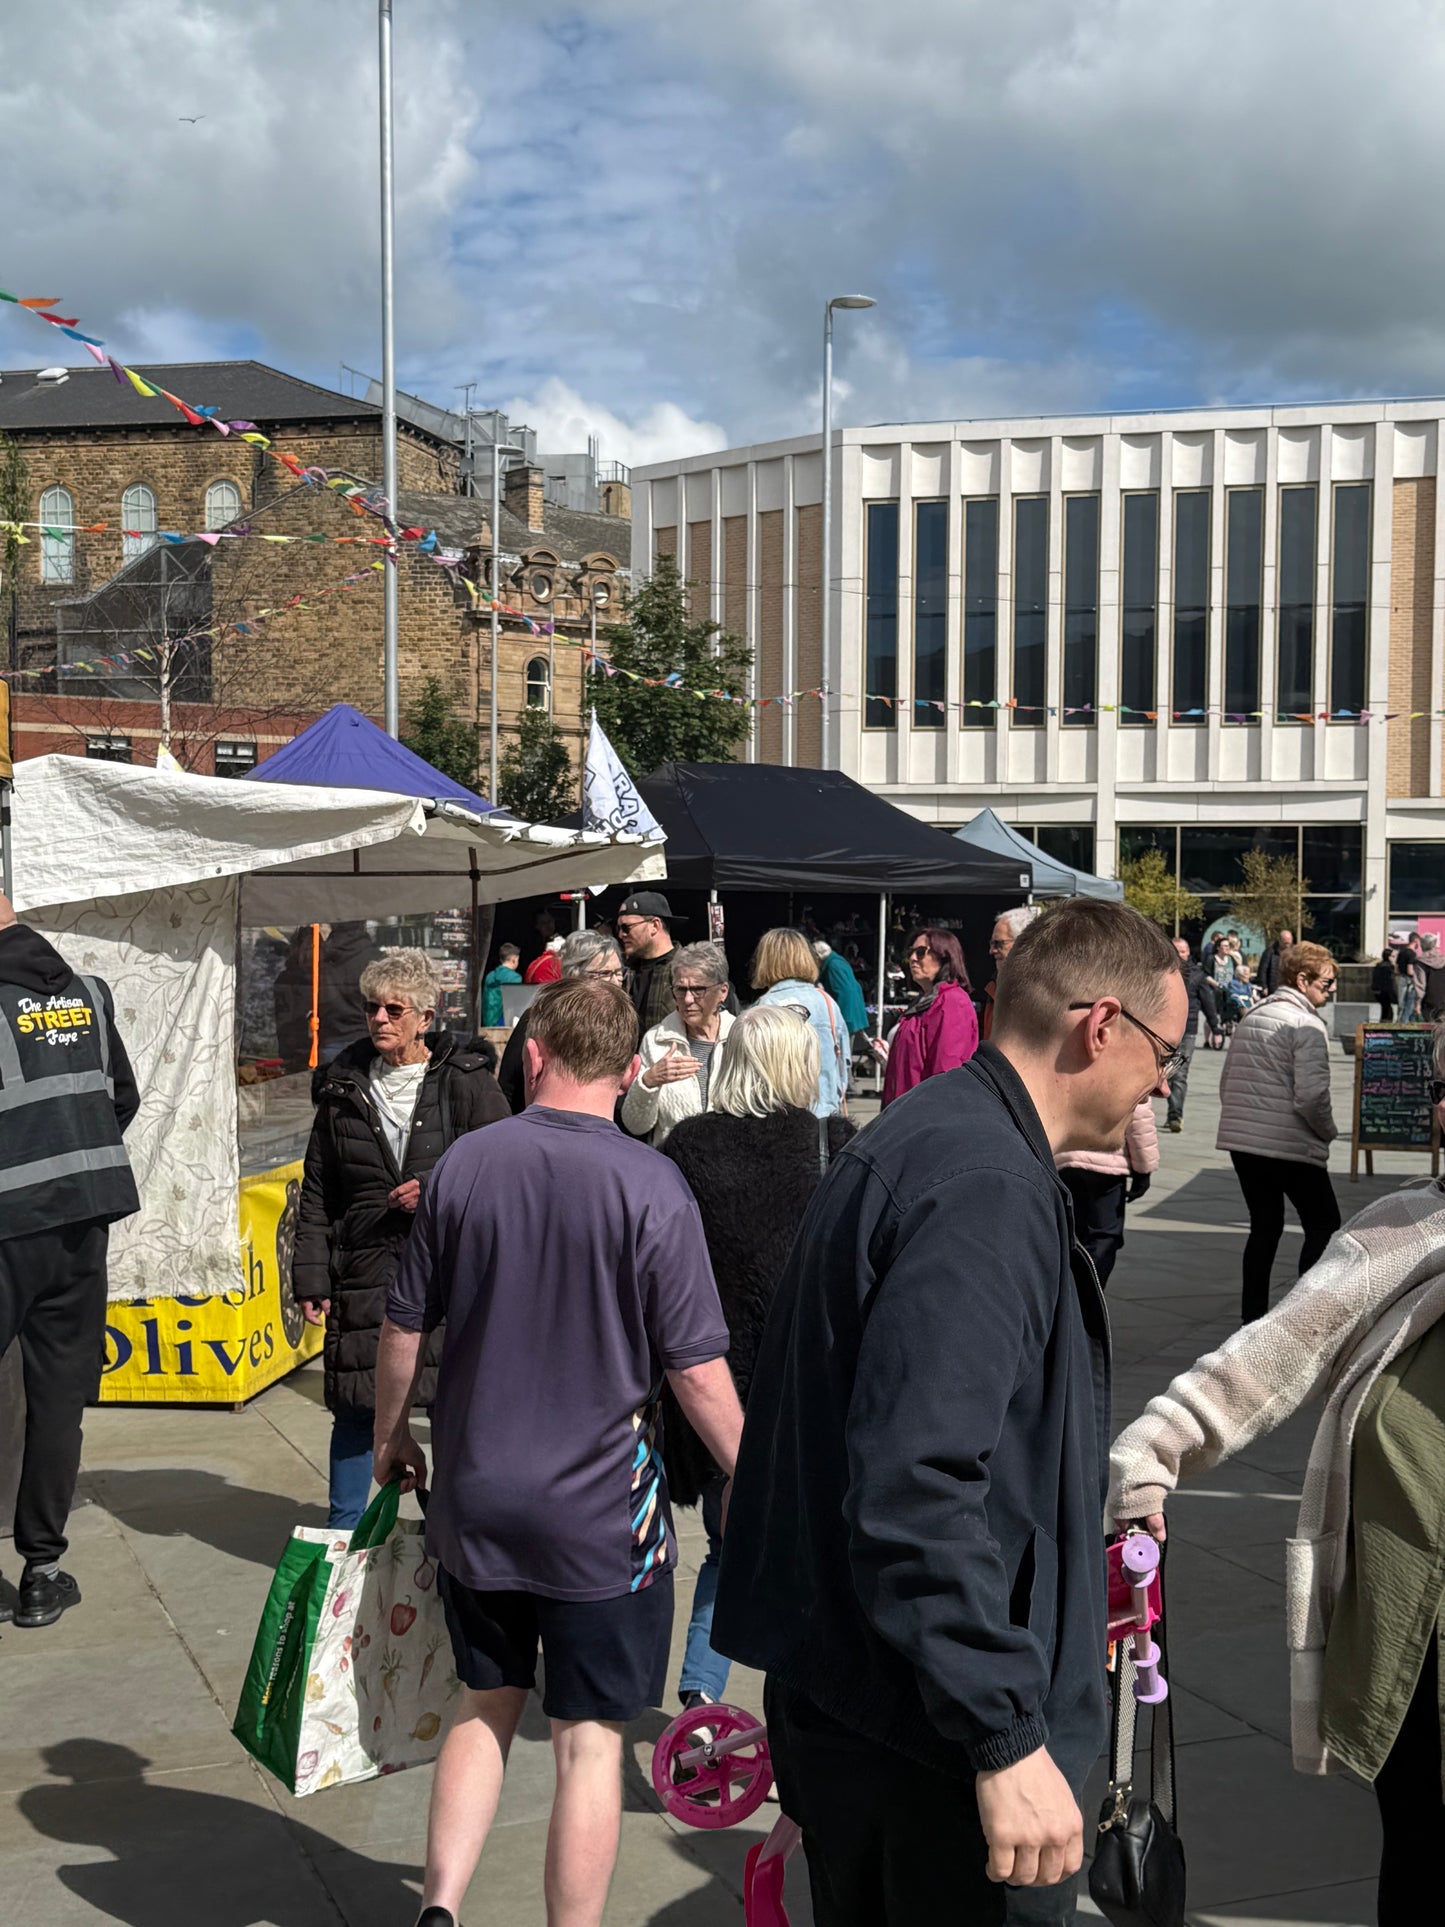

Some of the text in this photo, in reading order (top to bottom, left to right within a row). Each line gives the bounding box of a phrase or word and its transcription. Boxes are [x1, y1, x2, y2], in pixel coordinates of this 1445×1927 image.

[18, 995, 83, 1013] The Artisan
[17, 1008, 92, 1032] STREET
[270, 1648, 284, 1679] reasons
[288, 1601, 296, 1611] at
